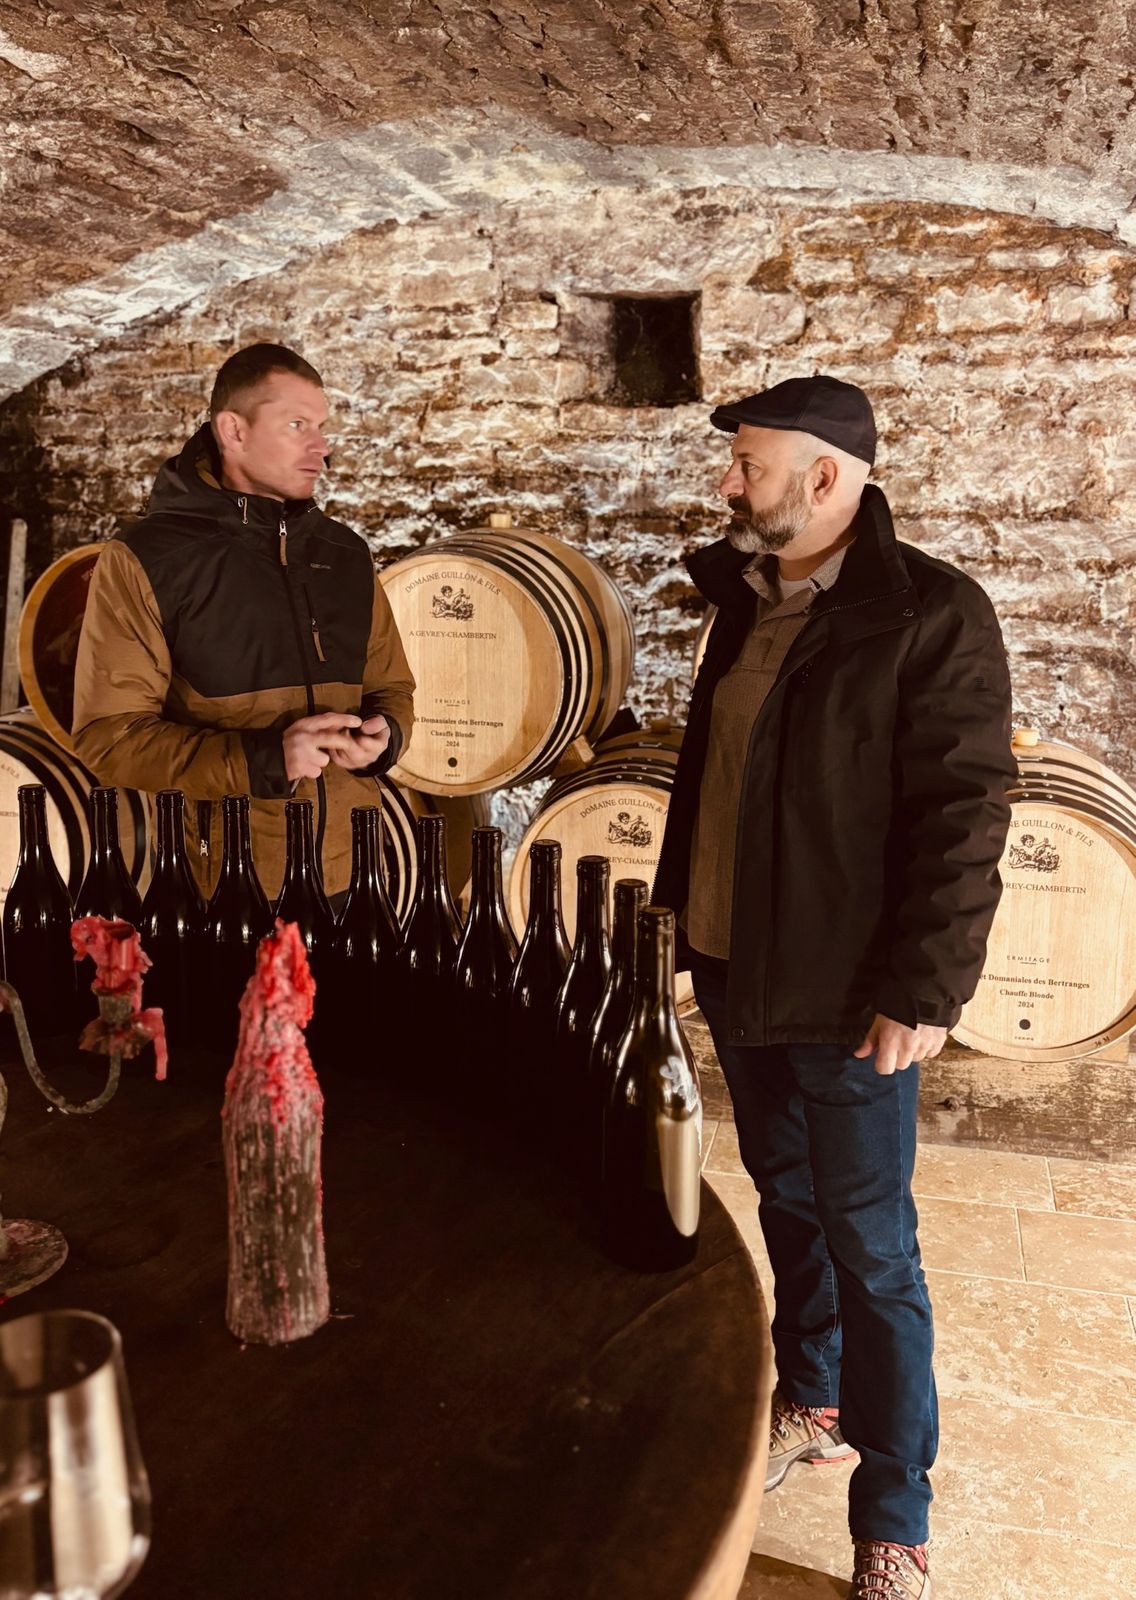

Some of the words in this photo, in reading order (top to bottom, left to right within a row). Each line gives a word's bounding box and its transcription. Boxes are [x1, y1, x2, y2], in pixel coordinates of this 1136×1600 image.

[405, 572, 440, 594] DOMAINE
[441, 571, 477, 582] GUILLON
[476, 577, 484, 586] &
[484, 582, 501, 596] FILS
[415, 630, 497, 640] GEVREY-CHAMBERTIN
[421, 717, 456, 725] Domaniales
[458, 718, 468, 726] des
[580, 799, 617, 819] DOMAINE
[618, 797, 656, 810] GUILLON
[656, 806, 664, 815] &
[1022, 819, 1066, 832] GUILLON
[1066, 828, 1074, 836] &
[1075, 831, 1095, 848] FILS
[608, 856, 658, 866] REY-CHAMBE
[1003, 882, 1087, 894] REY-CHAMBERTIN
[1007, 955, 1051, 963] ERMITAGE
[988, 974, 1032, 984] Domaniales
[1034, 976, 1046, 985] des
[1048, 979, 1090, 990] Bertranges
[1000, 989, 1028, 998] Chauffe
[1029, 990, 1055, 1000] Blonde
[1017, 1001, 1035, 1009] 2024
